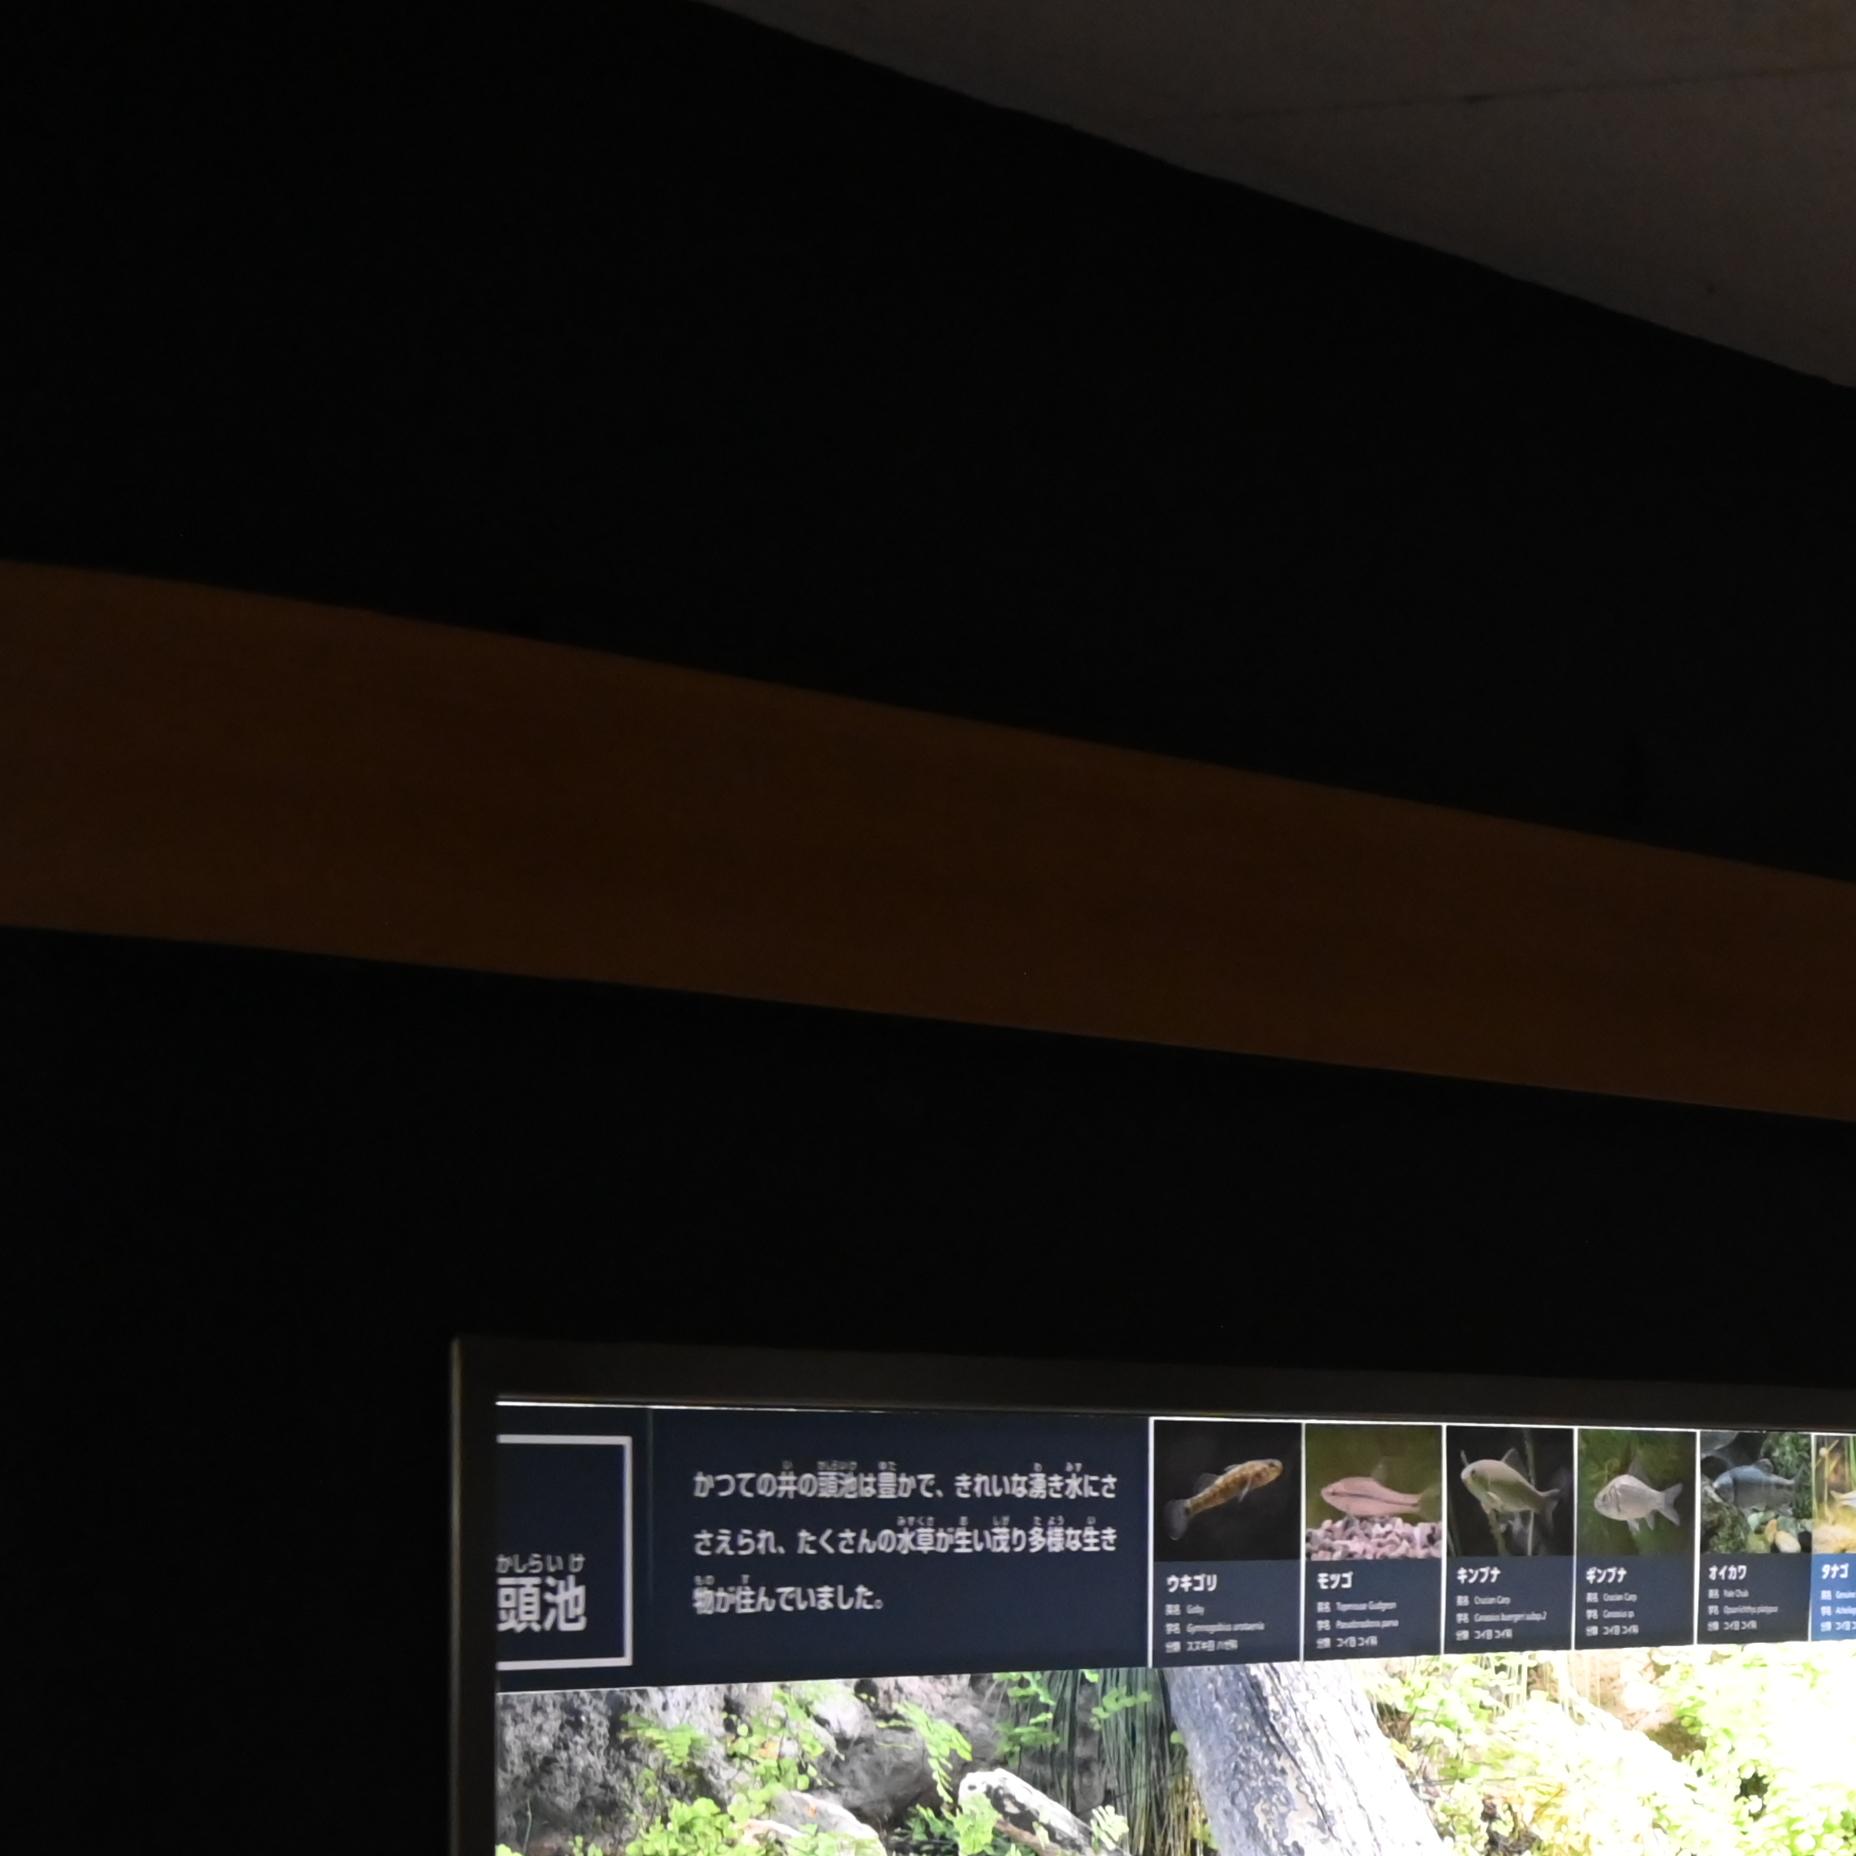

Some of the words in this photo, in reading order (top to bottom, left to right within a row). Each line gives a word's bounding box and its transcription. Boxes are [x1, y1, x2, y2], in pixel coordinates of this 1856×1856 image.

[693, 1471, 1118, 1499] かつての井の頭池は豊かで、きれいな湧き水にさ
[693, 1526, 1118, 1555] さえられ、たくさんの水草が生い茂り多様な生き
[495, 1552, 586, 1573] かしらいけ
[1708, 1564, 1747, 1581] オイカワ
[1821, 1562, 1849, 1580] タナゴ
[1166, 1573, 1218, 1593] ウキゴリ
[1317, 1571, 1354, 1589] モツゴ
[1456, 1566, 1501, 1584] キンブナ
[1586, 1566, 1627, 1584] ギンブナ
[496, 1574, 587, 1634] 頭池
[692, 1585, 884, 1615] 物が住んでいました。
